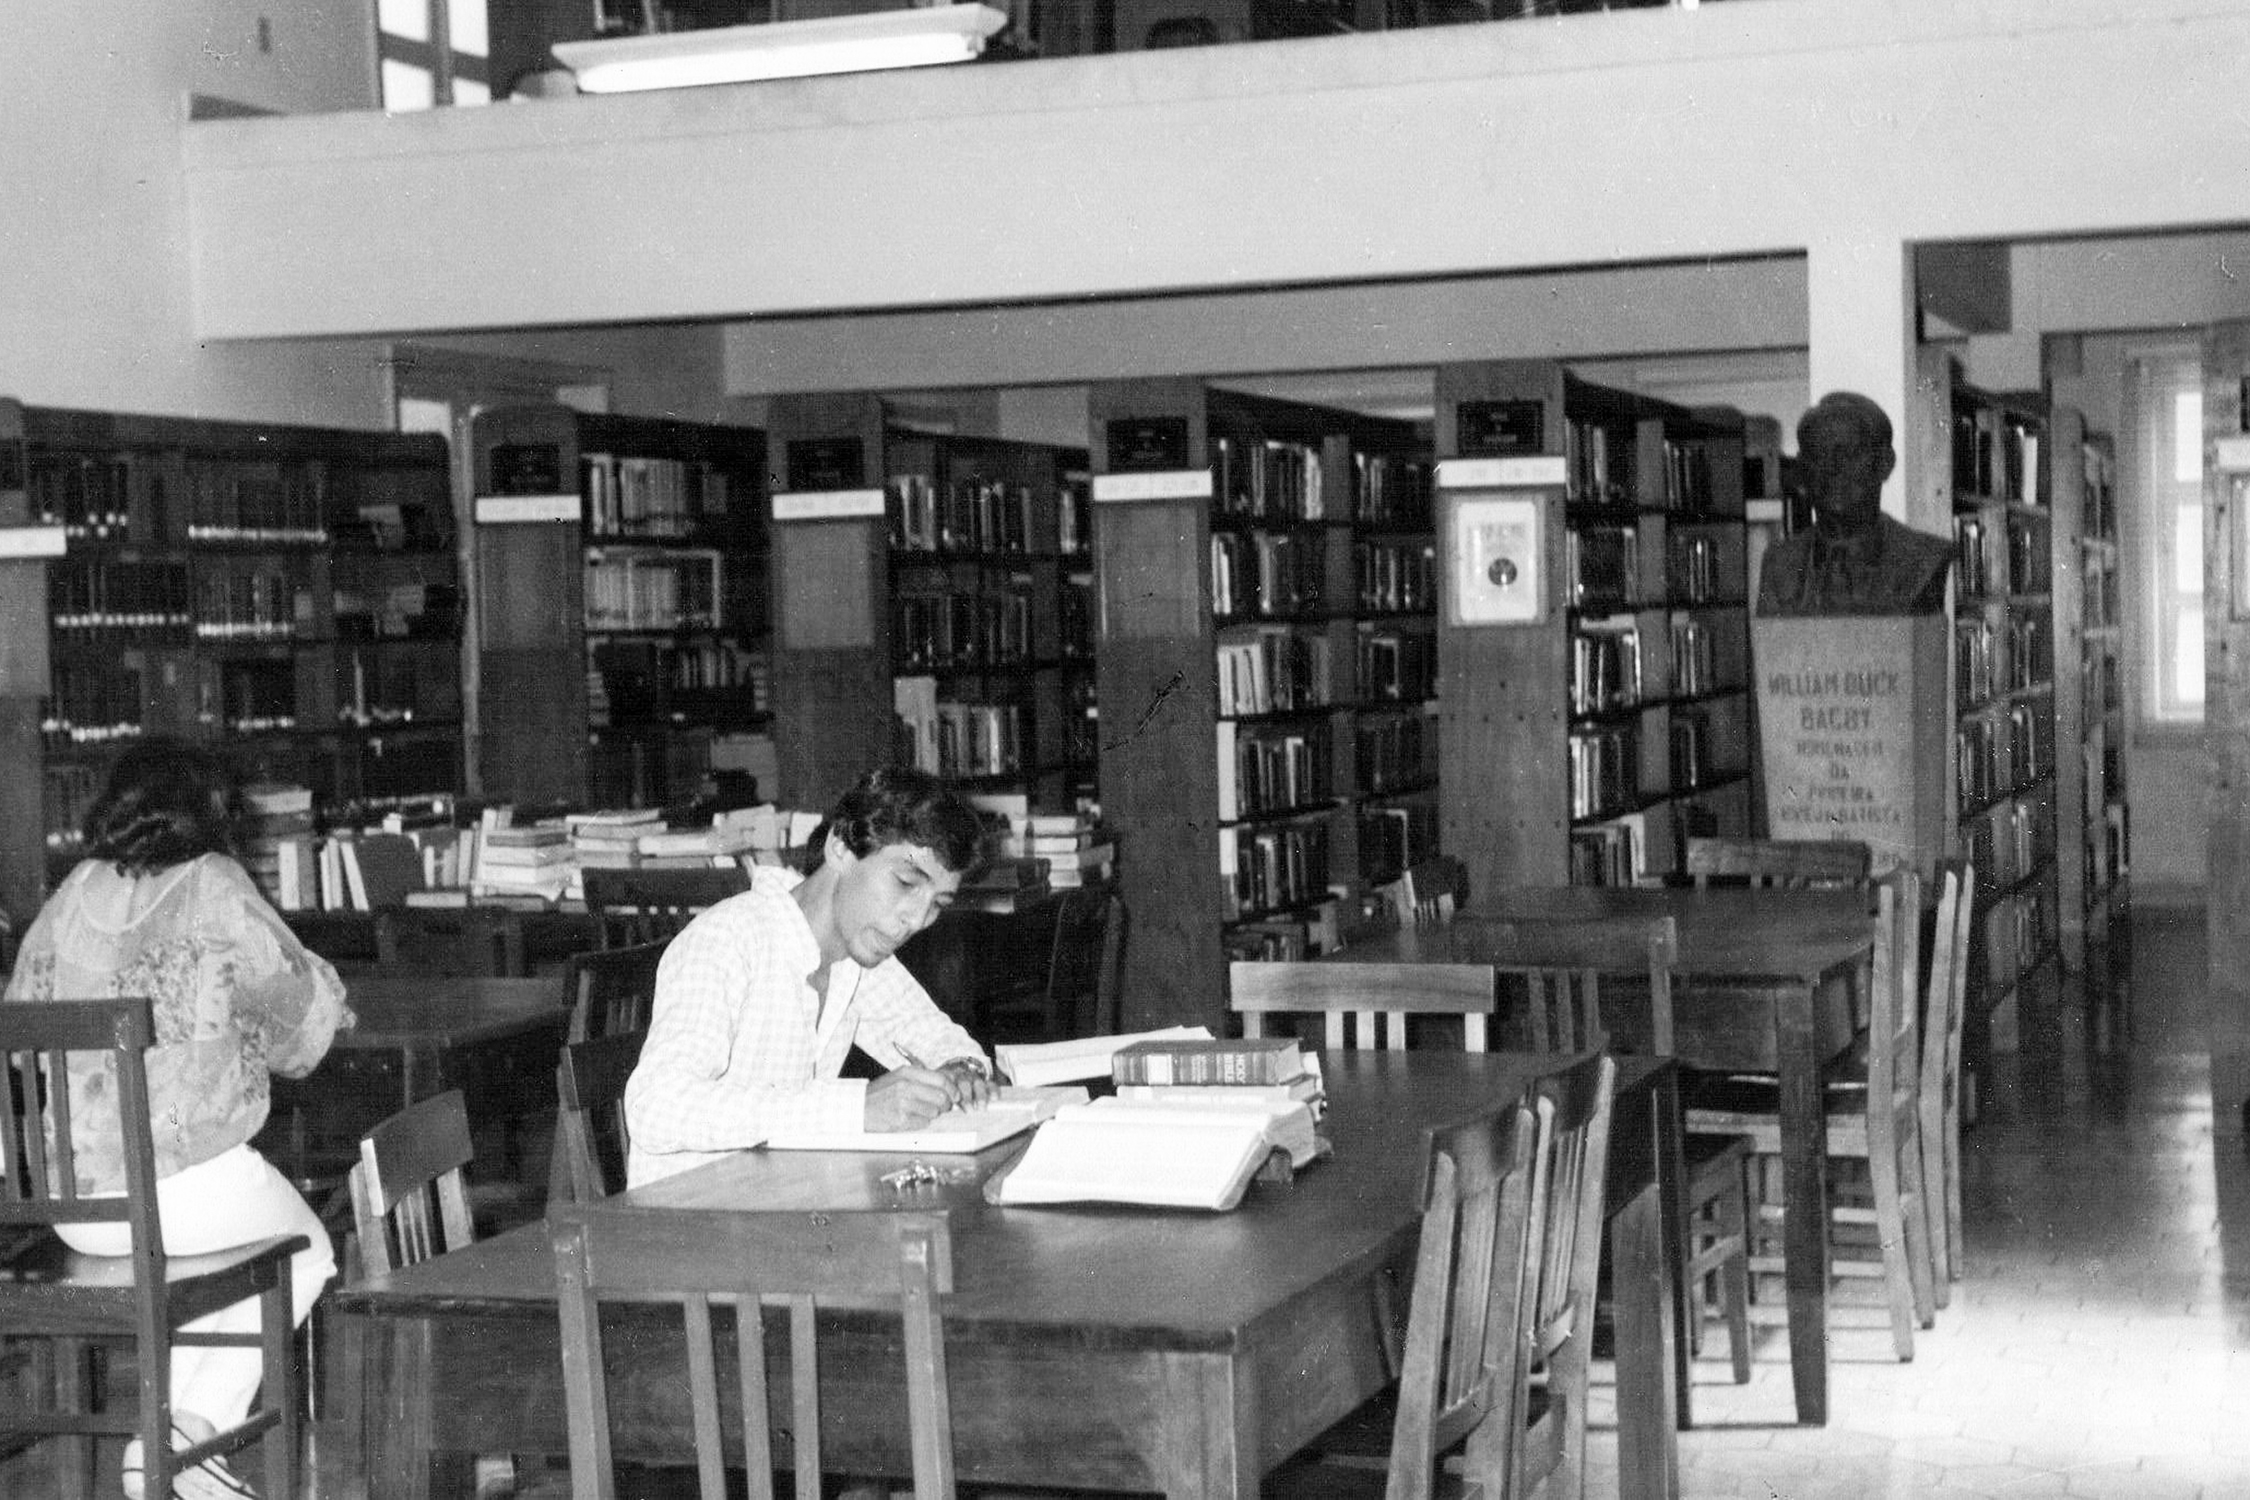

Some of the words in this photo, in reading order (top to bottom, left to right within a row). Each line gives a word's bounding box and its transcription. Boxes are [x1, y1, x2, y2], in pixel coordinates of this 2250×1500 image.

[1768, 671, 1838, 696] WILLIAM
[1843, 671, 1899, 696] BUCK
[1800, 706, 1870, 730] BAGBY
[1223, 1053, 1235, 1084] BIBLE
[1235, 1053, 1246, 1084] HOLY
